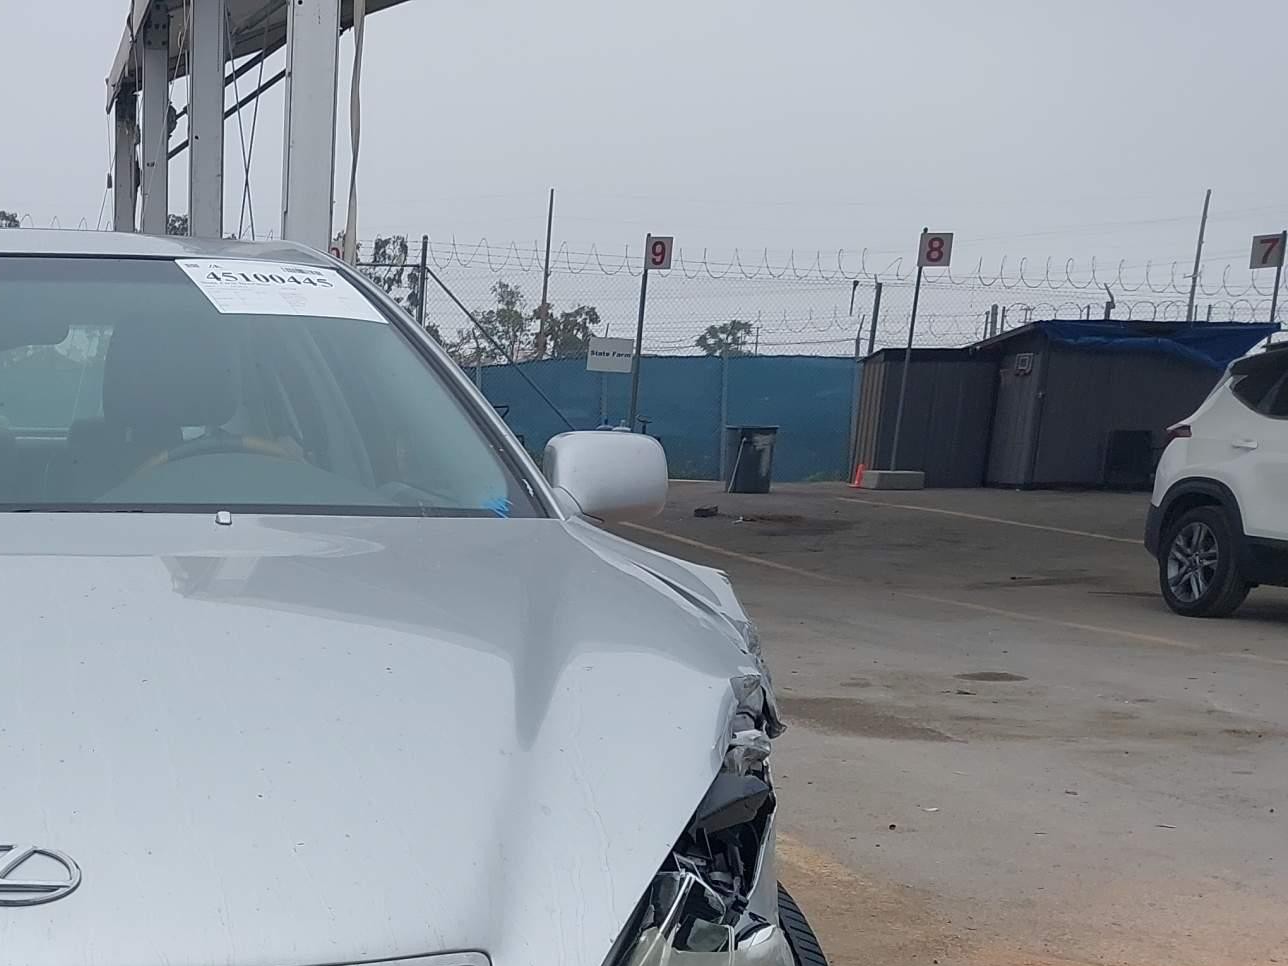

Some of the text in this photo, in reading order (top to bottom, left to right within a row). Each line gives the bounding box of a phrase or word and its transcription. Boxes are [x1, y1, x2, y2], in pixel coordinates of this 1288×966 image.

[652, 241, 665, 265] 9
[926, 237, 944, 262] 8
[1260, 238, 1280, 264] 7
[206, 271, 334, 288] 45100445
